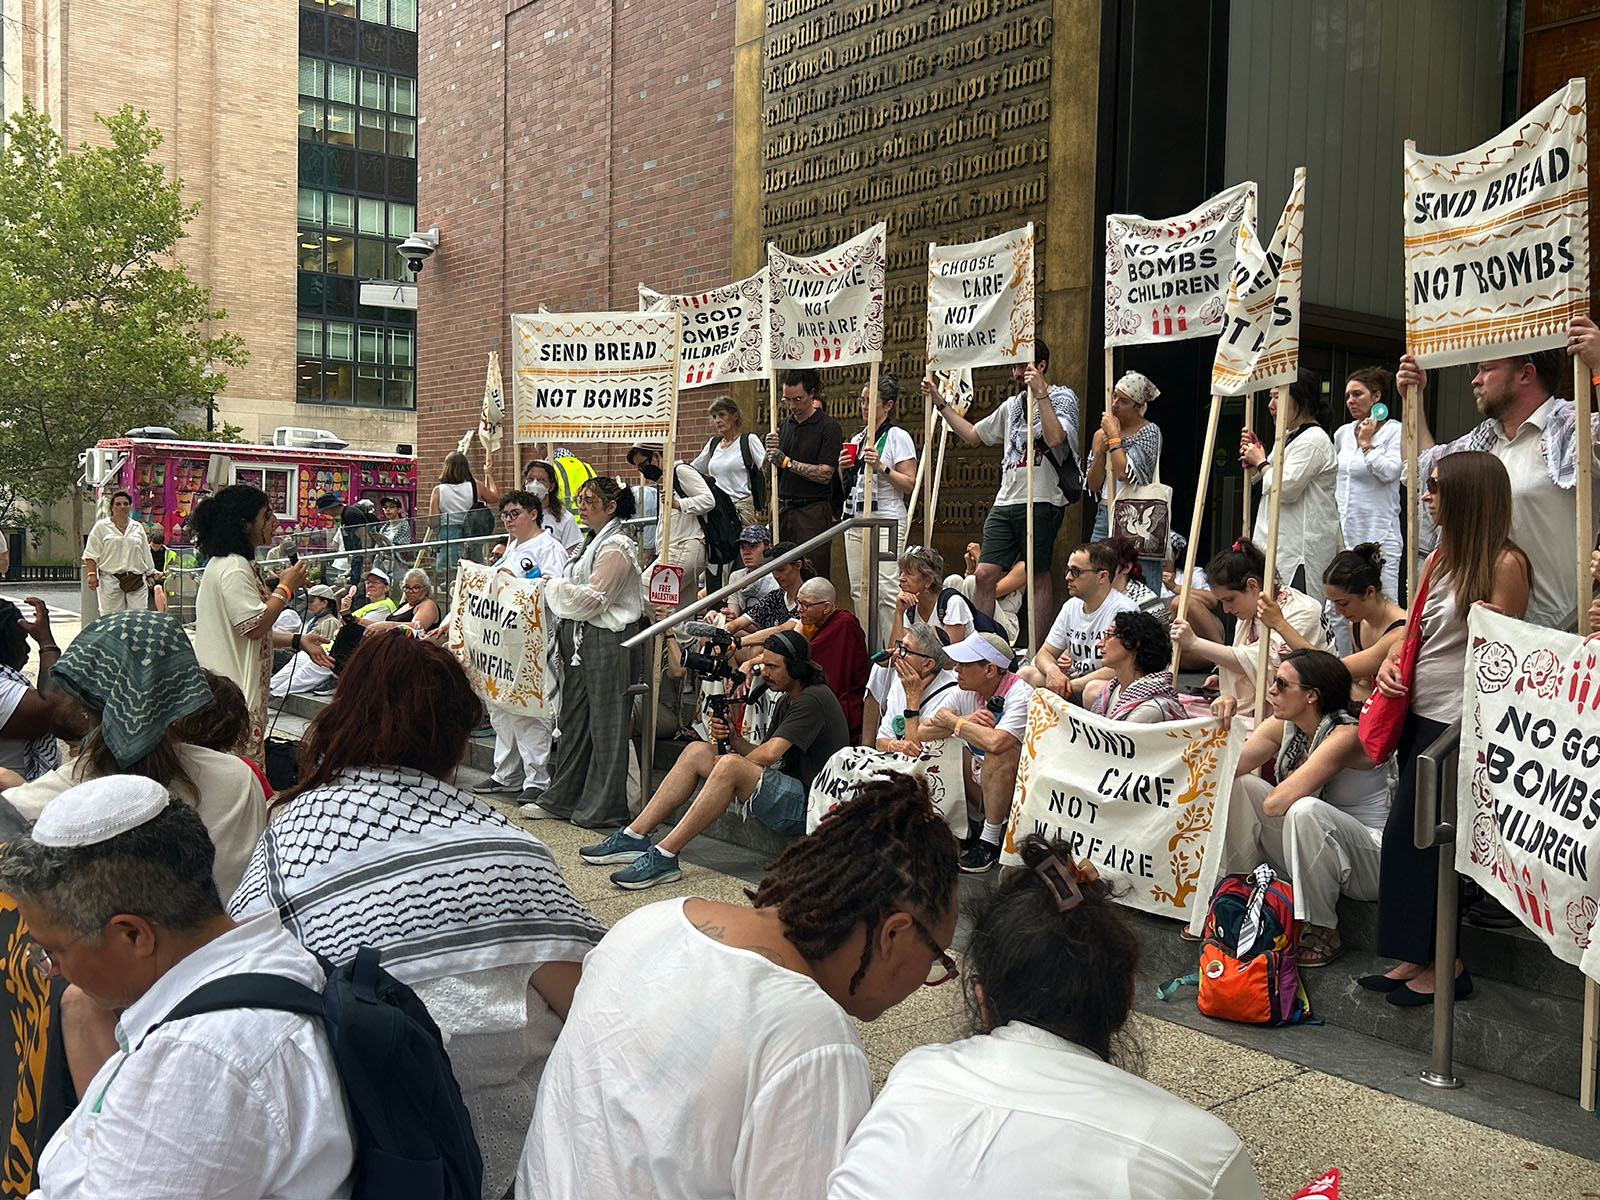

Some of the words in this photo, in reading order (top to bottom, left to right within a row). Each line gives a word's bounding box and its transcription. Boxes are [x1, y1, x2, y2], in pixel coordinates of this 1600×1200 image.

[1413, 189, 1476, 224] SEND
[1482, 146, 1570, 212] BREAD
[1124, 243, 1159, 258] NO
[1165, 230, 1216, 253] GOD
[941, 254, 996, 276] CHOOSE
[1128, 248, 1218, 282] BOMBS
[1414, 263, 1466, 305] NOT
[1470, 236, 1574, 293] BOMBS
[962, 274, 1004, 298] CARE
[1128, 274, 1220, 304] CHILDREN
[694, 306, 742, 324] GOD
[804, 300, 830, 317] NOT
[944, 304, 978, 325] NOT
[682, 322, 740, 344] OMBS
[938, 329, 996, 349] WARFARE
[540, 343, 588, 361] SEND
[595, 340, 657, 360] BREAD
[681, 338, 736, 360] HILDREN
[536, 388, 577, 408] NOT
[583, 387, 654, 408] BOMBS
[652, 592, 678, 602] PALESTINE
[658, 584, 672, 592] FREE
[1068, 716, 1136, 759] FUND
[1495, 706, 1556, 748] NO
[1098, 768, 1175, 808] CARE
[1048, 789, 1099, 824] NOT
[1494, 800, 1588, 882] HILDREN
